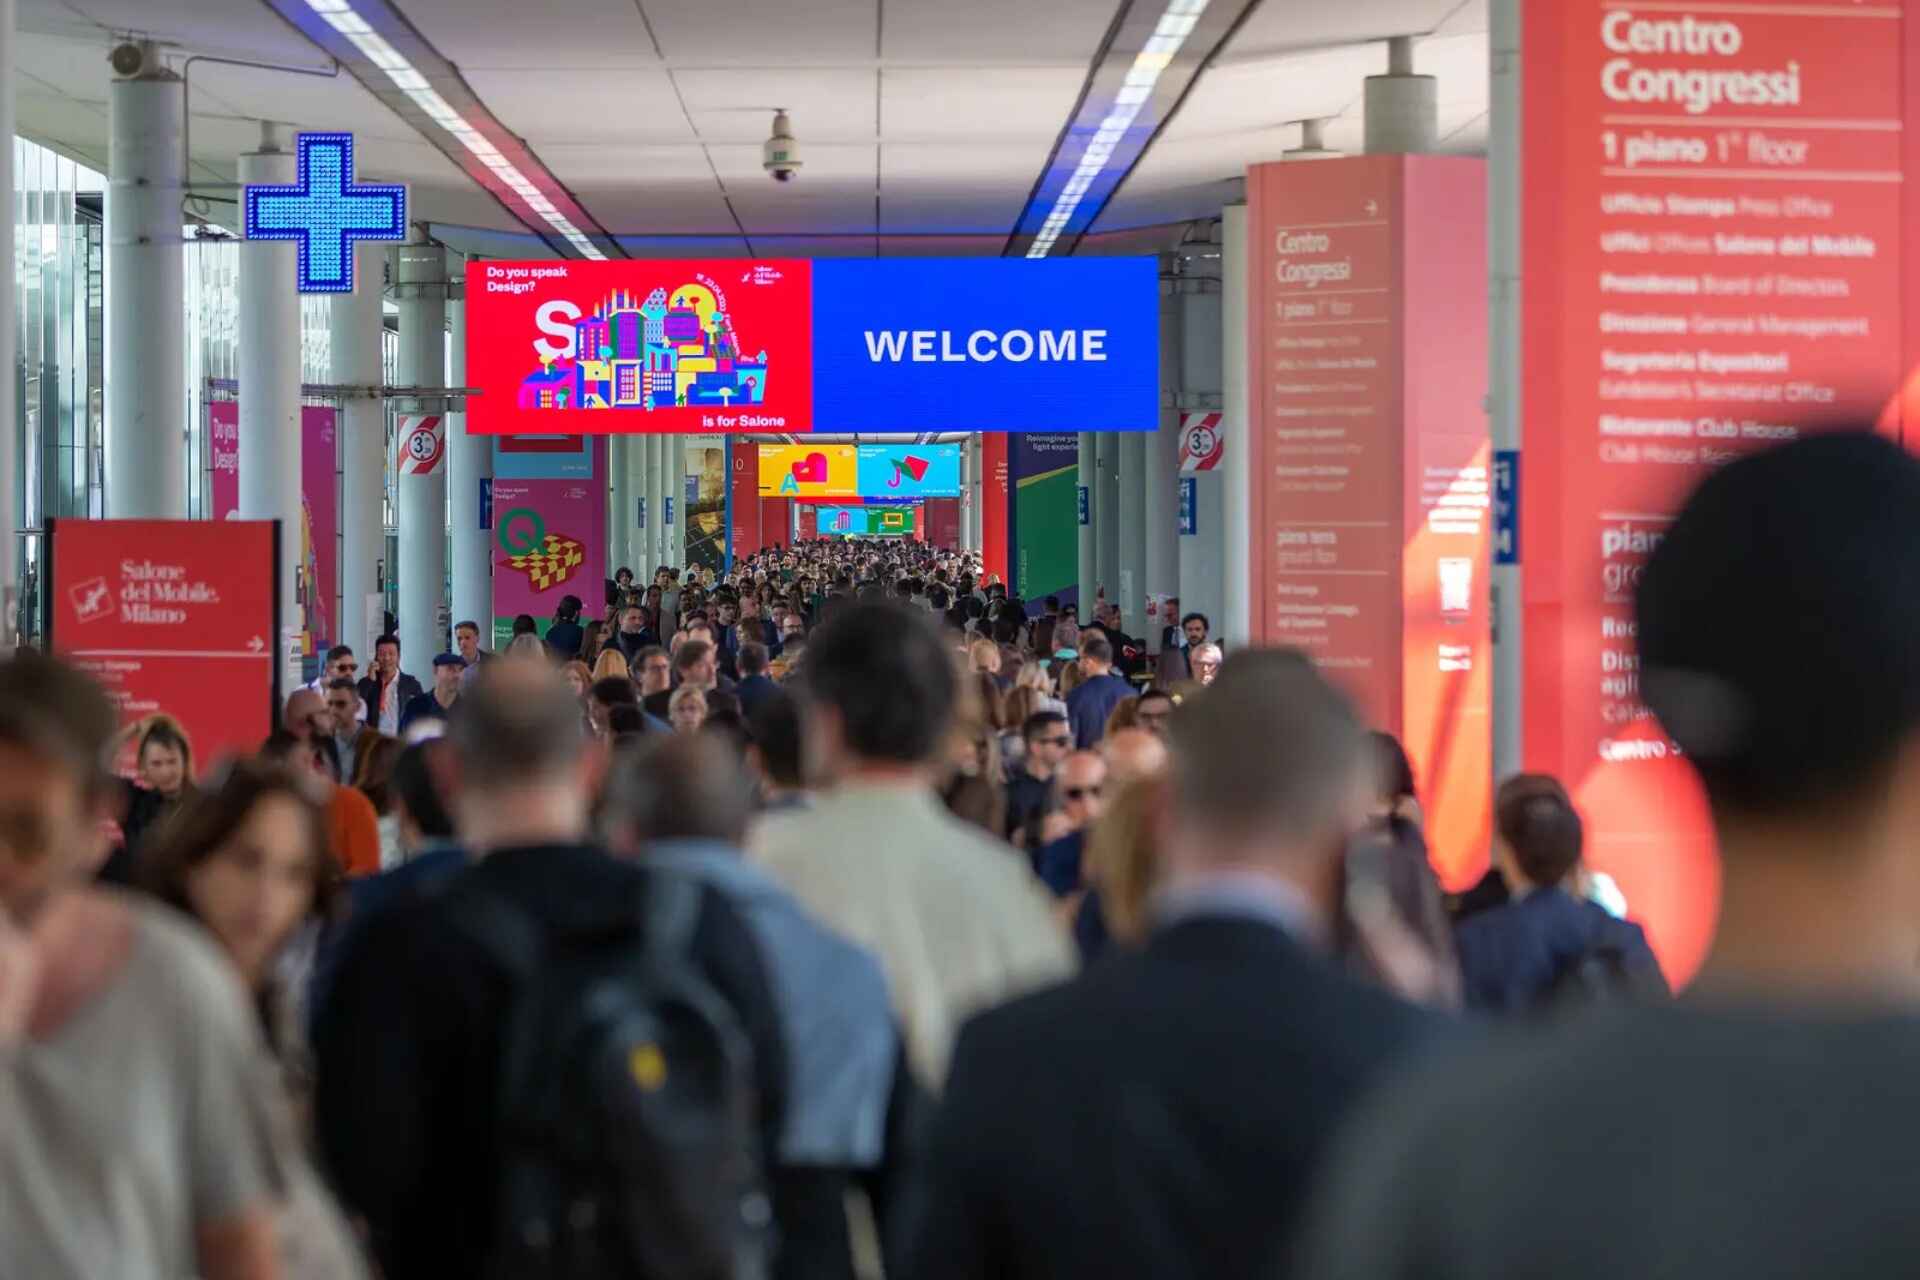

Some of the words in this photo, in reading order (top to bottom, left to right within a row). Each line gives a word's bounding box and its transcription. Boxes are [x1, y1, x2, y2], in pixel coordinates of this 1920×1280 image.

[1601, 9, 1742, 55] Centro
[1601, 58, 1800, 113] Congressi
[1602, 130, 1617, 160] 1
[1625, 129, 1708, 168] piano
[1748, 132, 1809, 164] floor
[1276, 231, 1330, 254] Centro
[487, 267, 504, 277] Do
[507, 268, 529, 279] you
[531, 266, 568, 280] speak
[1276, 256, 1351, 288] Congressi
[487, 281, 536, 295] Design?
[532, 300, 582, 360] S
[864, 329, 1108, 362] WELCOME
[702, 415, 714, 427] is
[716, 415, 737, 427] for
[739, 415, 786, 427] Salone
[1697, 416, 1739, 438] Club
[414, 436, 424, 453] 3
[1192, 432, 1201, 450] 3
[781, 472, 800, 493] A
[887, 466, 902, 488] J
[499, 507, 550, 557] Q
[121, 559, 185, 580] Salone
[121, 581, 151, 602] del
[120, 603, 187, 624] Milano
